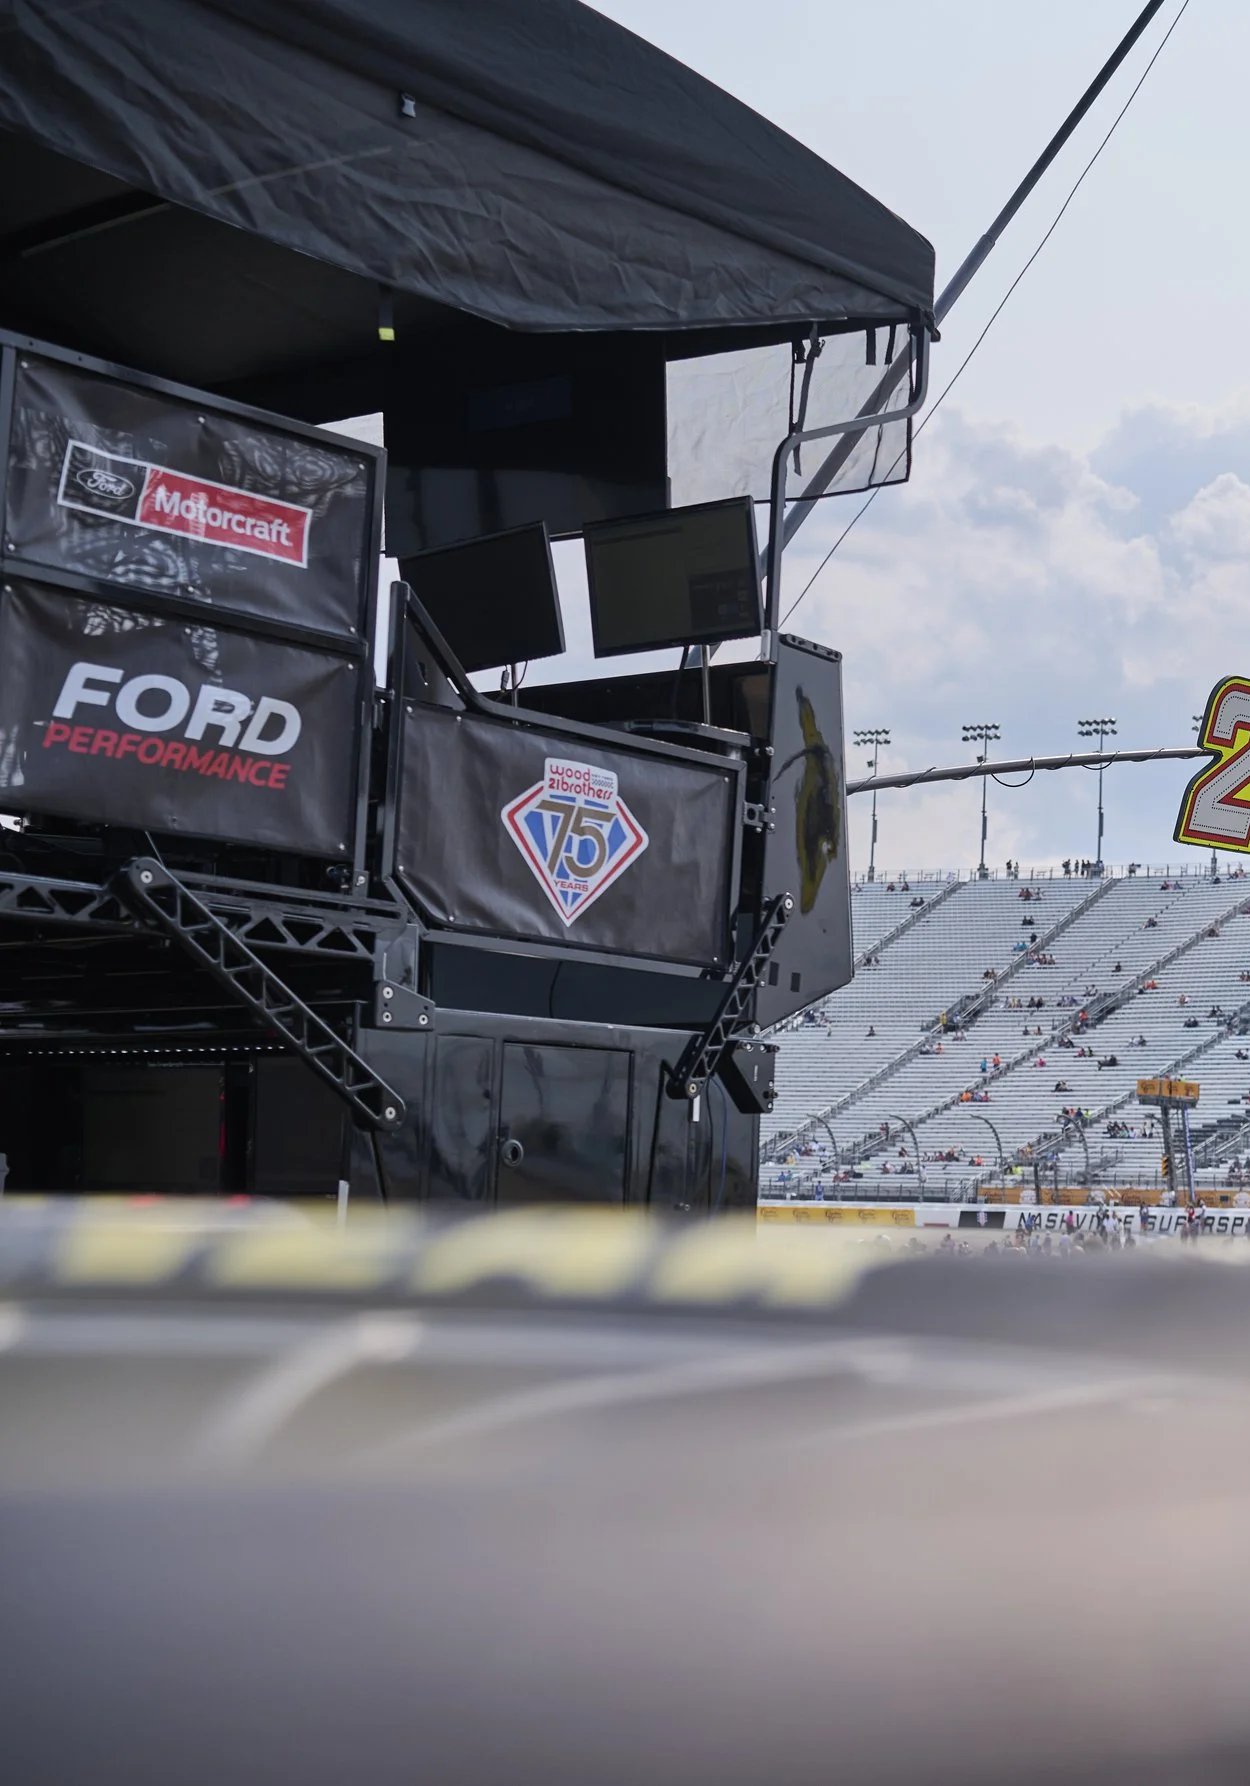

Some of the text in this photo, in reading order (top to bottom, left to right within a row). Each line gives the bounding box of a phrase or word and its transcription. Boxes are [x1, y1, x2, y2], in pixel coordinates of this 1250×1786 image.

[154, 487, 292, 547] Motorcraft
[52, 661, 301, 756] FORD
[42, 723, 292, 790] PERFORMANCE
[549, 764, 591, 782] wood
[534, 799, 618, 879] 75
[553, 879, 589, 892] YEARS
